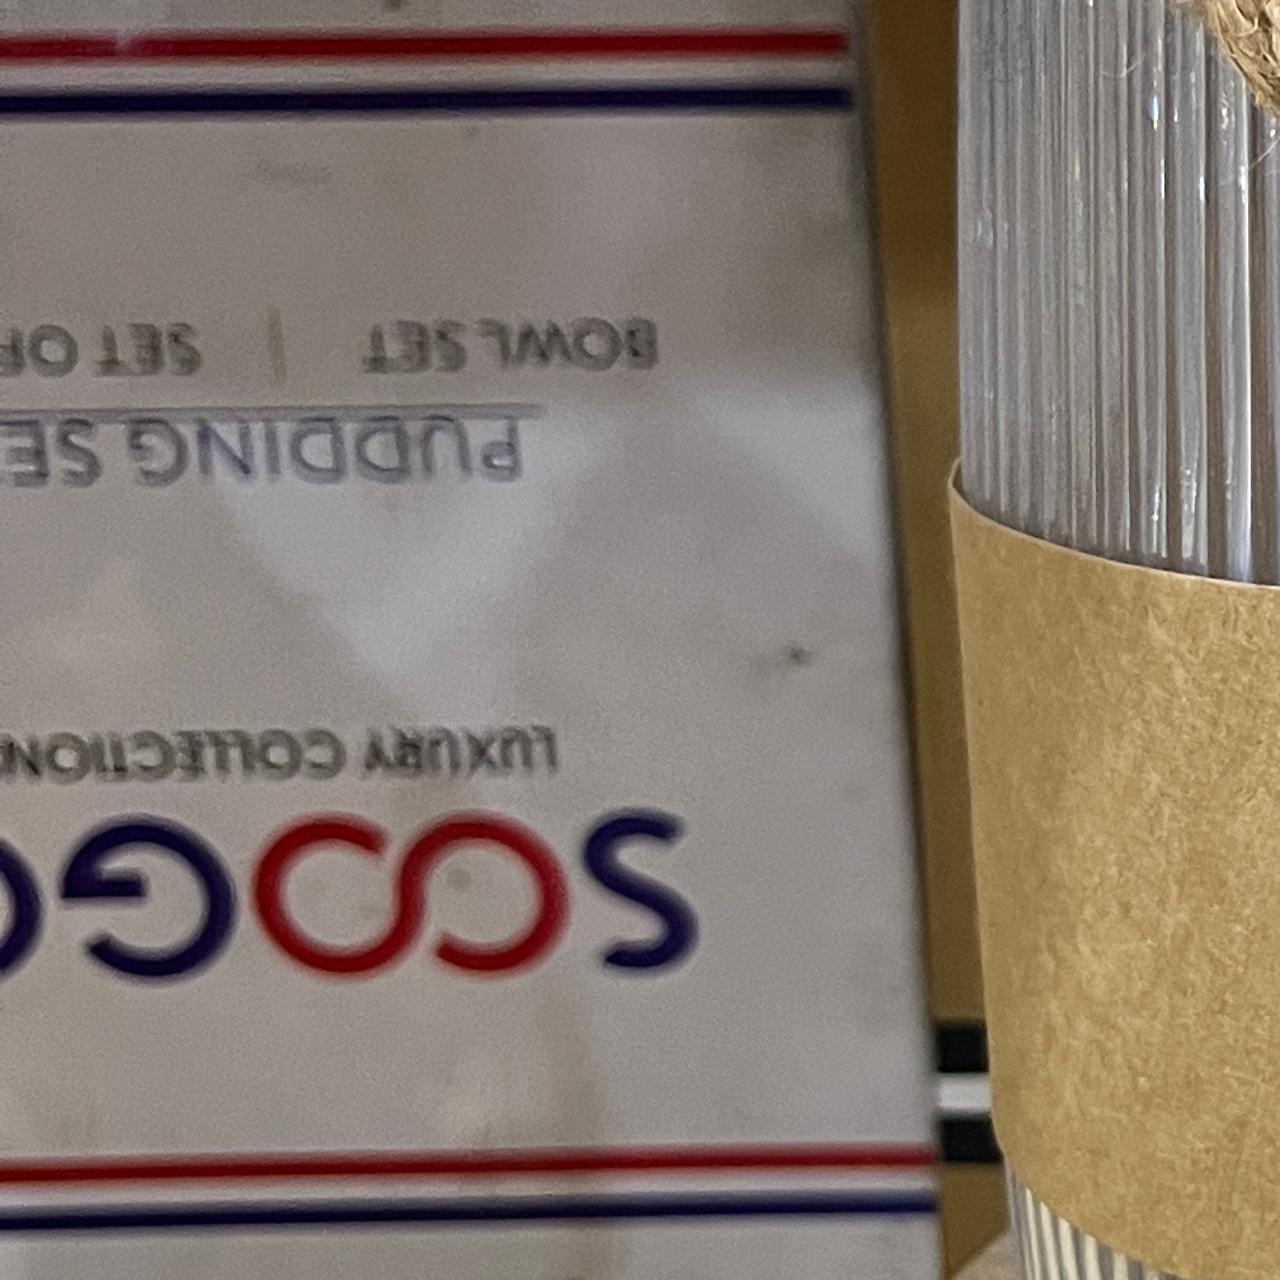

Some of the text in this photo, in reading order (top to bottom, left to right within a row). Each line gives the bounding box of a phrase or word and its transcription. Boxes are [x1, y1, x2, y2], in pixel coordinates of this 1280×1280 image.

[97, 321, 202, 377] SET
[361, 322, 470, 376] SET
[480, 316, 660, 372] BOWL
[130, 416, 524, 487] PUDDING
[366, 723, 560, 780] LUXURY
[0, 806, 700, 982] SOOG
